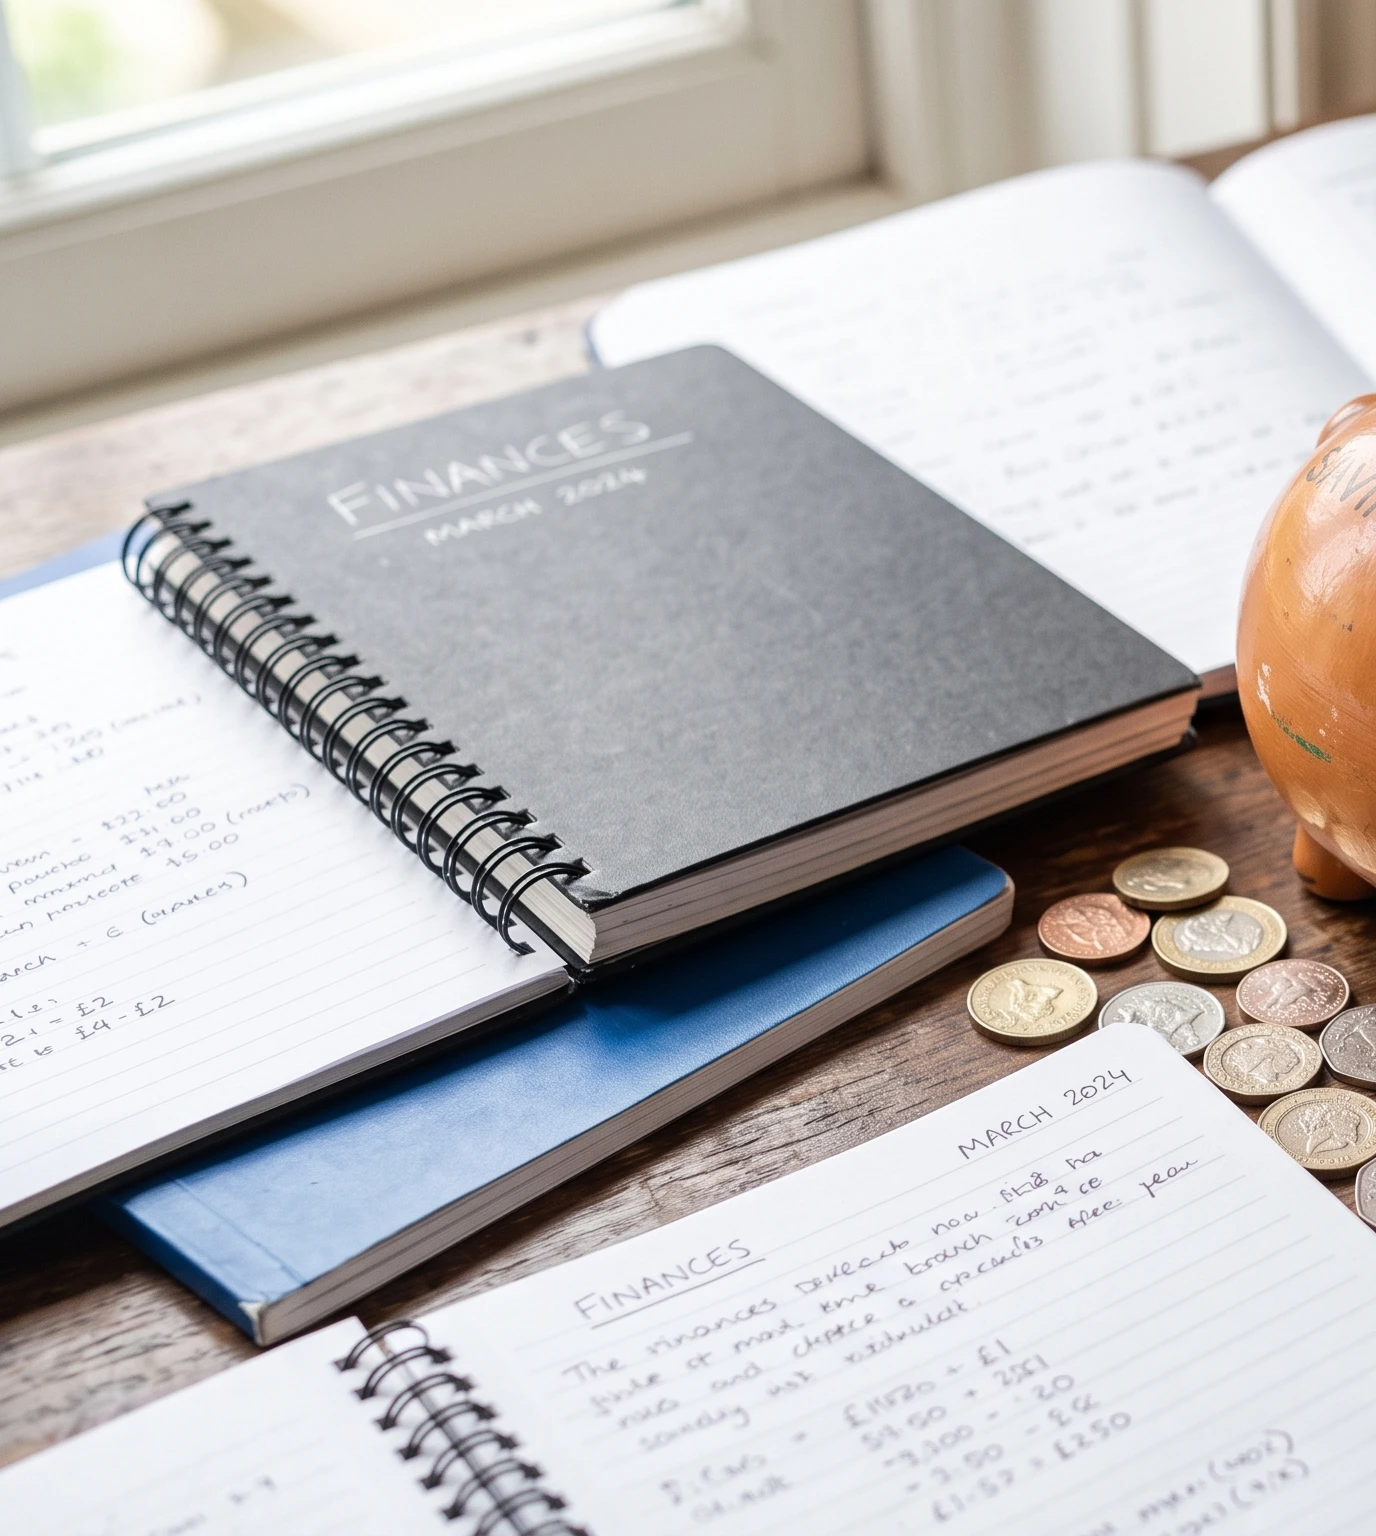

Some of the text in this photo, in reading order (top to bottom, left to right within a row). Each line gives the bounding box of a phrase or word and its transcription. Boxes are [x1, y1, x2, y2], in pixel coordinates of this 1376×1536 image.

[327, 409, 650, 526] FINANCES
[424, 468, 648, 546] MARCH 2024
[76, 996, 114, 1018] £2
[135, 995, 176, 1017] £2
[957, 1069, 1133, 1160] MARCH 2024
[573, 1239, 752, 1320] FINANCES
[562, 1356, 626, 1382] The
